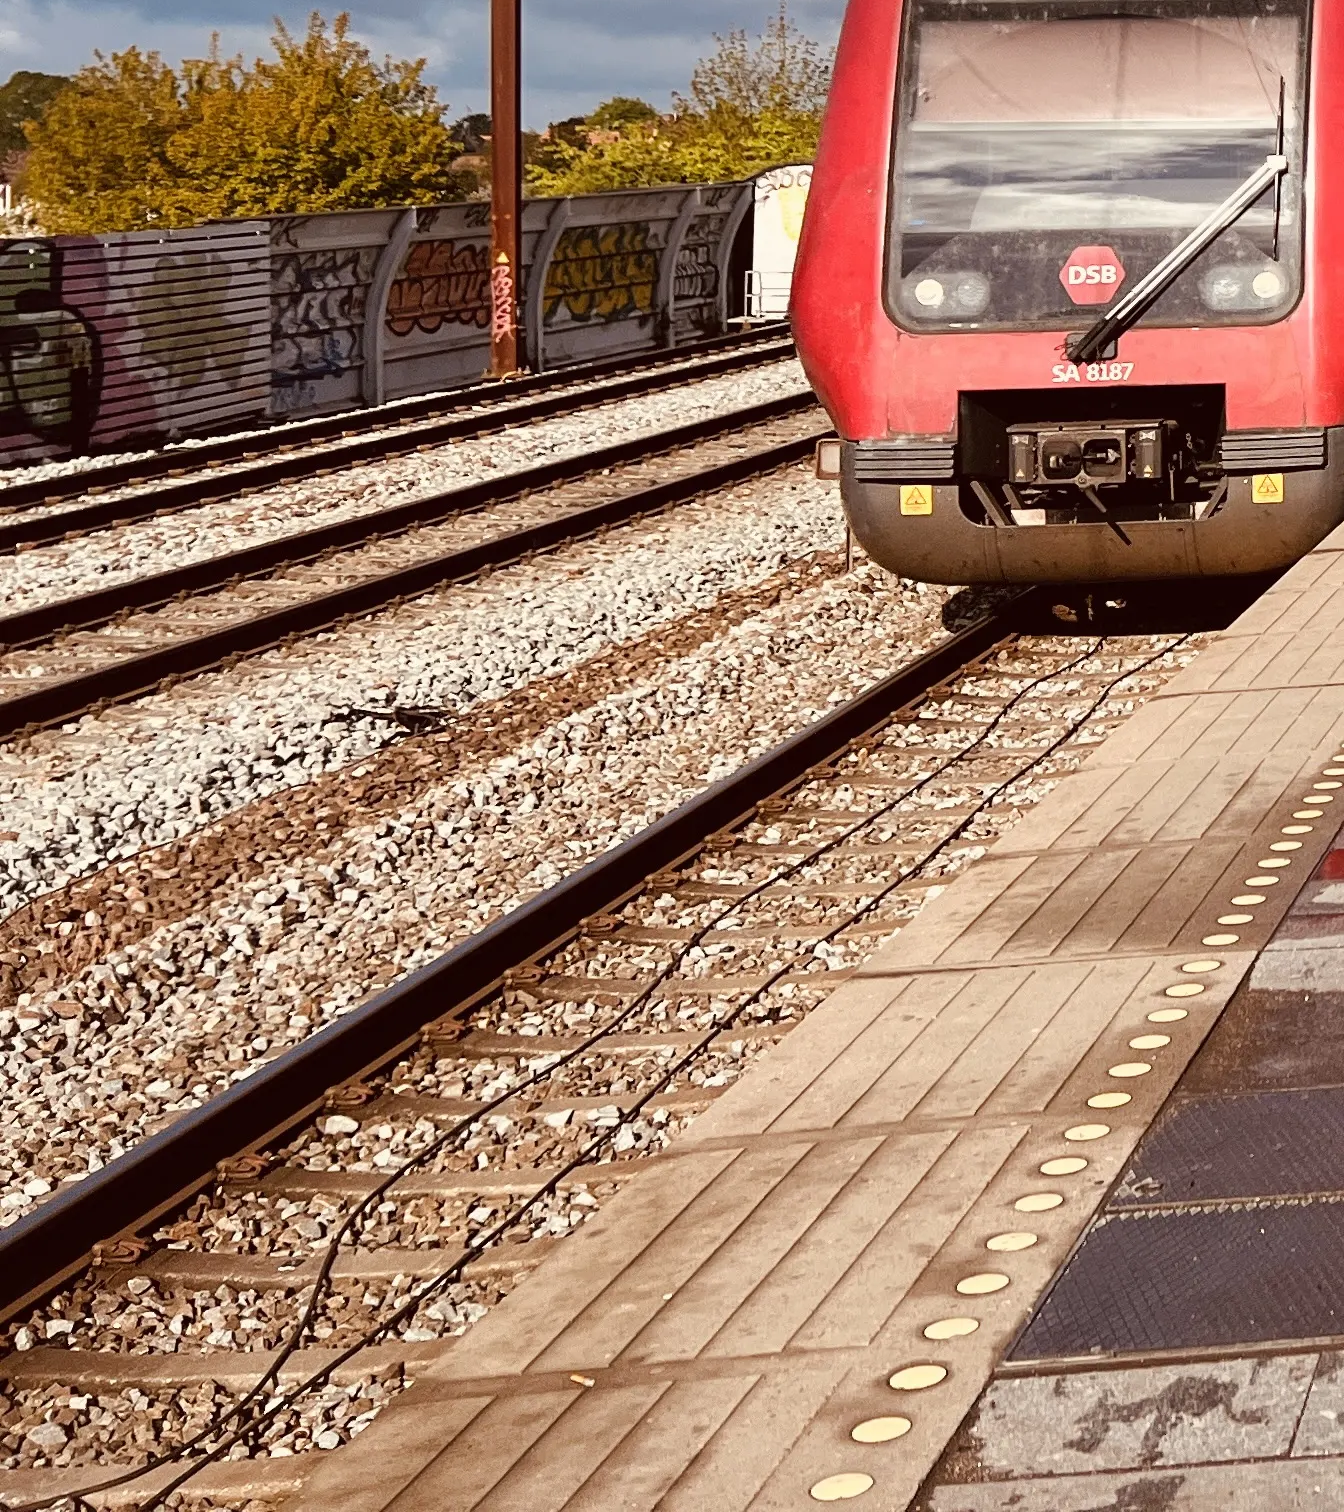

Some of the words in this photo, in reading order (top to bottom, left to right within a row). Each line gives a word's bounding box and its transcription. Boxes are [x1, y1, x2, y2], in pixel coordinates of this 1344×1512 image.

[1068, 264, 1117, 285] DSB
[1051, 365, 1081, 384] SA
[1086, 362, 1135, 382] 8187
